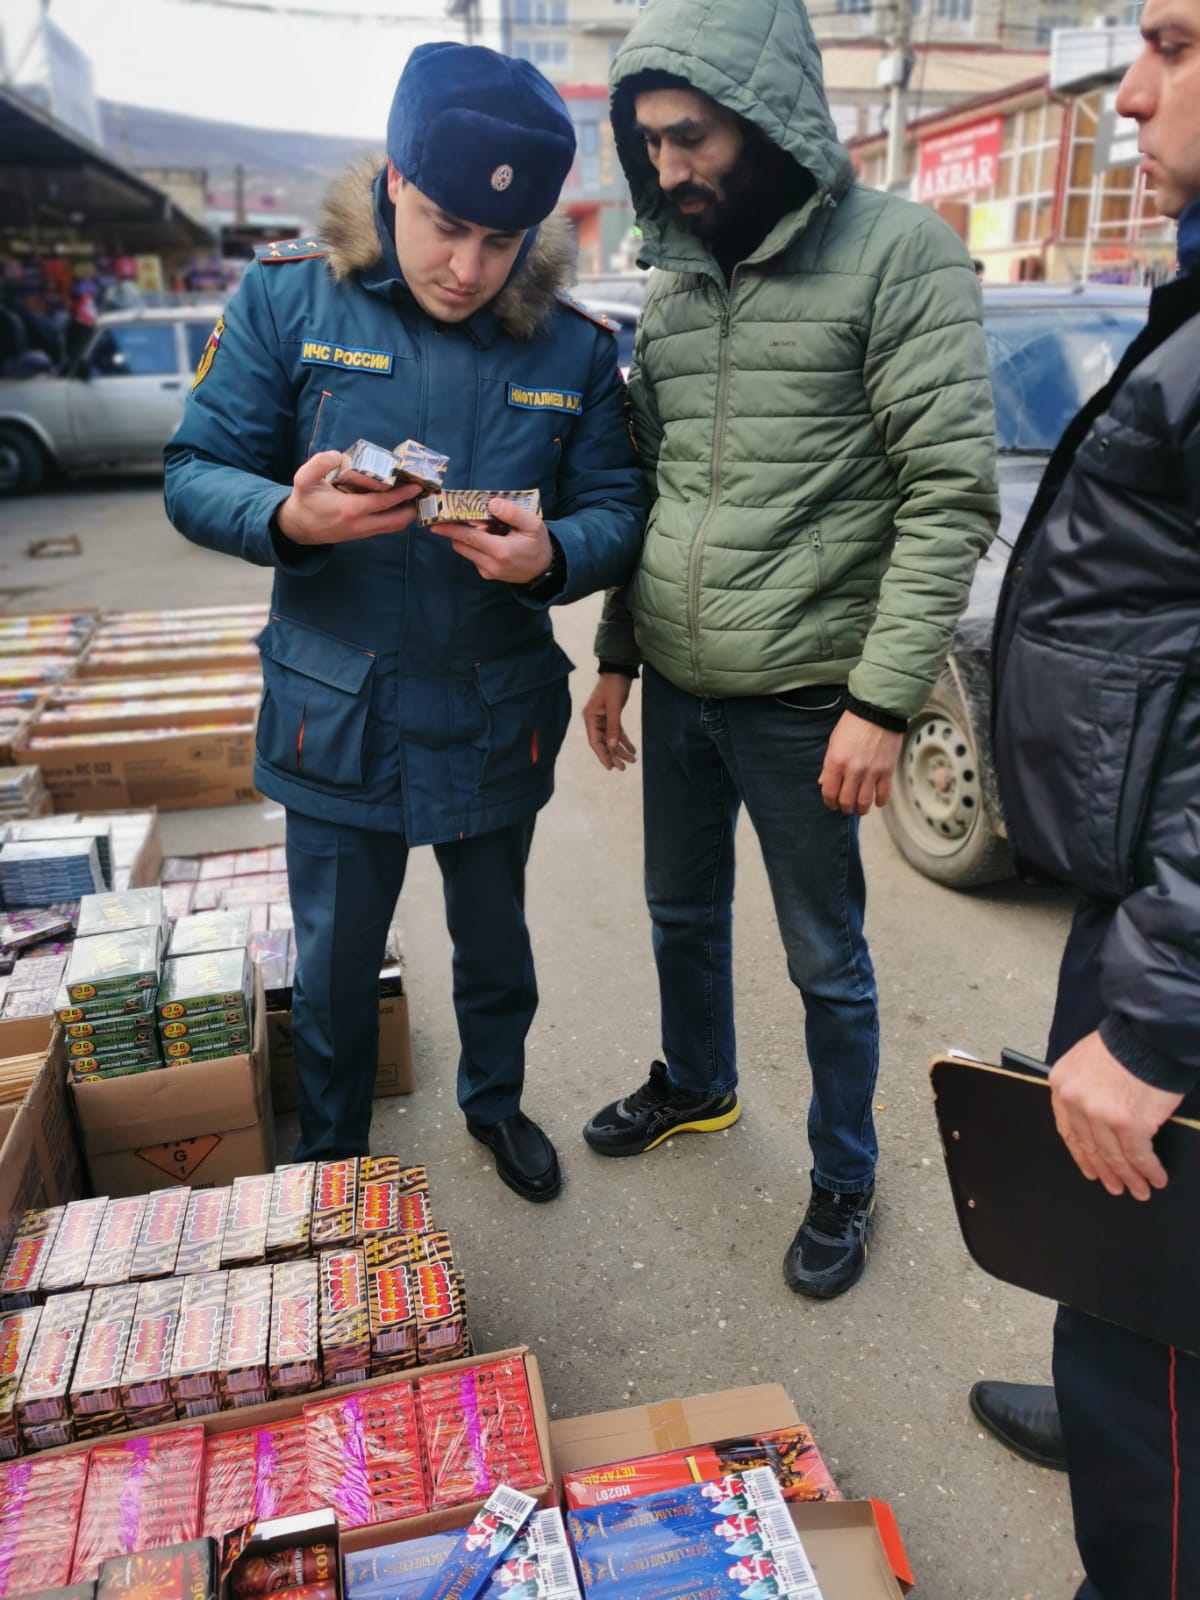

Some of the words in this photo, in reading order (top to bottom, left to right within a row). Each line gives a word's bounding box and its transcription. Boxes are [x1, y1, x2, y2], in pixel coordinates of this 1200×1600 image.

[919, 155, 993, 199] AKBAR
[303, 343, 331, 360] МЧС
[333, 348, 390, 370] РОССИИ
[173, 1150, 187, 1161] G
